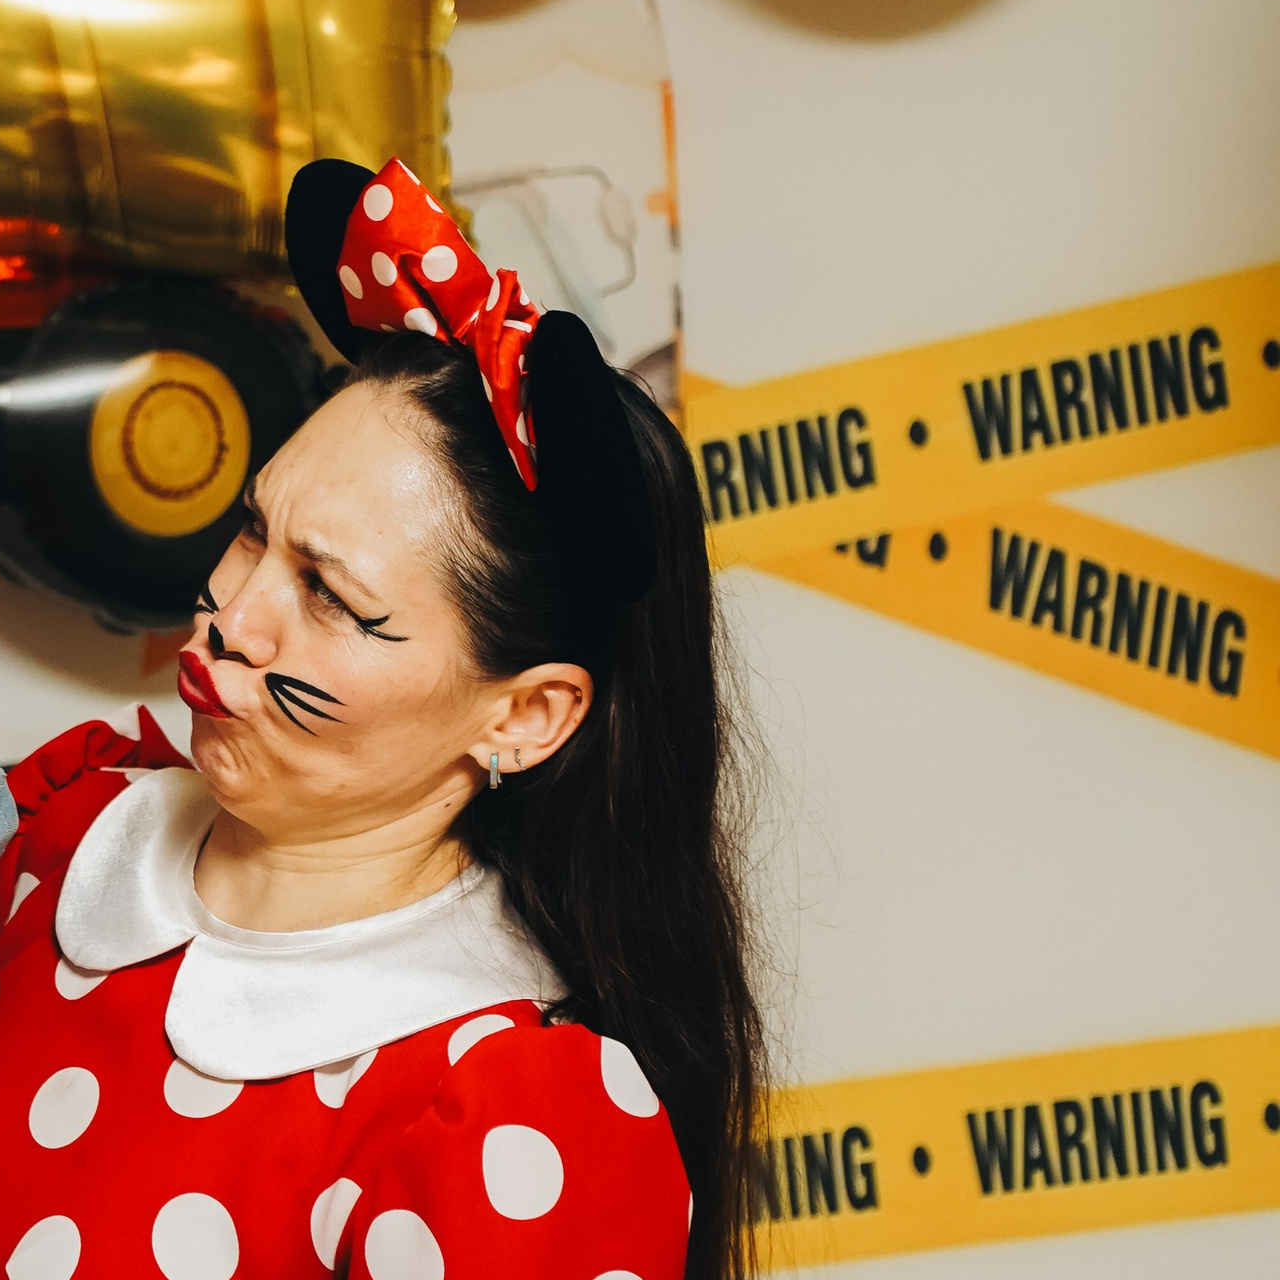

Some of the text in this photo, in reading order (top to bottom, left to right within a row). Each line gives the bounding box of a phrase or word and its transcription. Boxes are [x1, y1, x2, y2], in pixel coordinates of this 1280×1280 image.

[701, 325, 1230, 523] RNING WARNING
[988, 526, 1248, 698] WARNING
[966, 1080, 1229, 1196] WARNING
